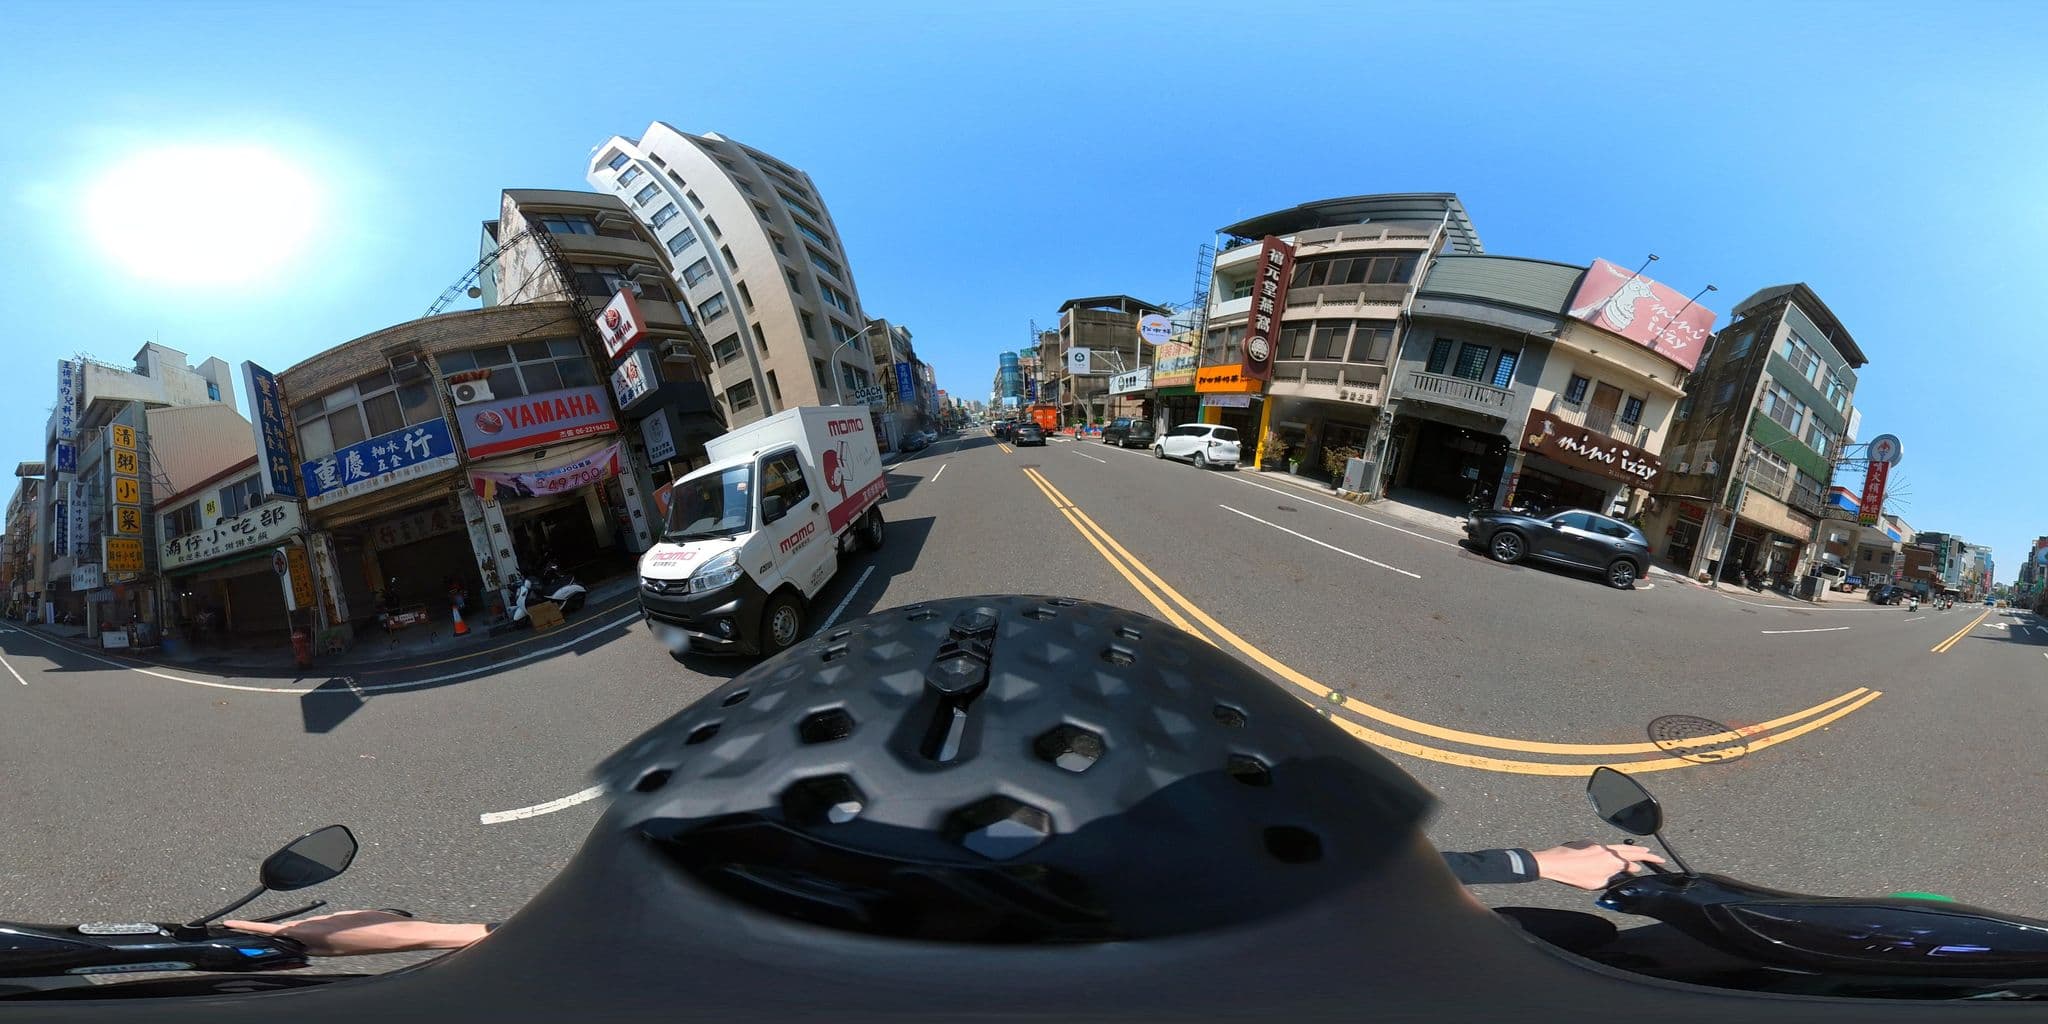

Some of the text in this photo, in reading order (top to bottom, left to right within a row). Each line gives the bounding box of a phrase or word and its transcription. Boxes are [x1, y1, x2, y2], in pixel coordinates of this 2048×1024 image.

[609, 320, 632, 348] YAMAHA
[855, 387, 881, 399] COACH
[502, 394, 600, 430] YAMAHA
[827, 419, 864, 437] momo
[404, 428, 433, 460] 行
[1557, 435, 1616, 464] mini
[314, 450, 370, 489] 重慶
[780, 521, 815, 553] momo
